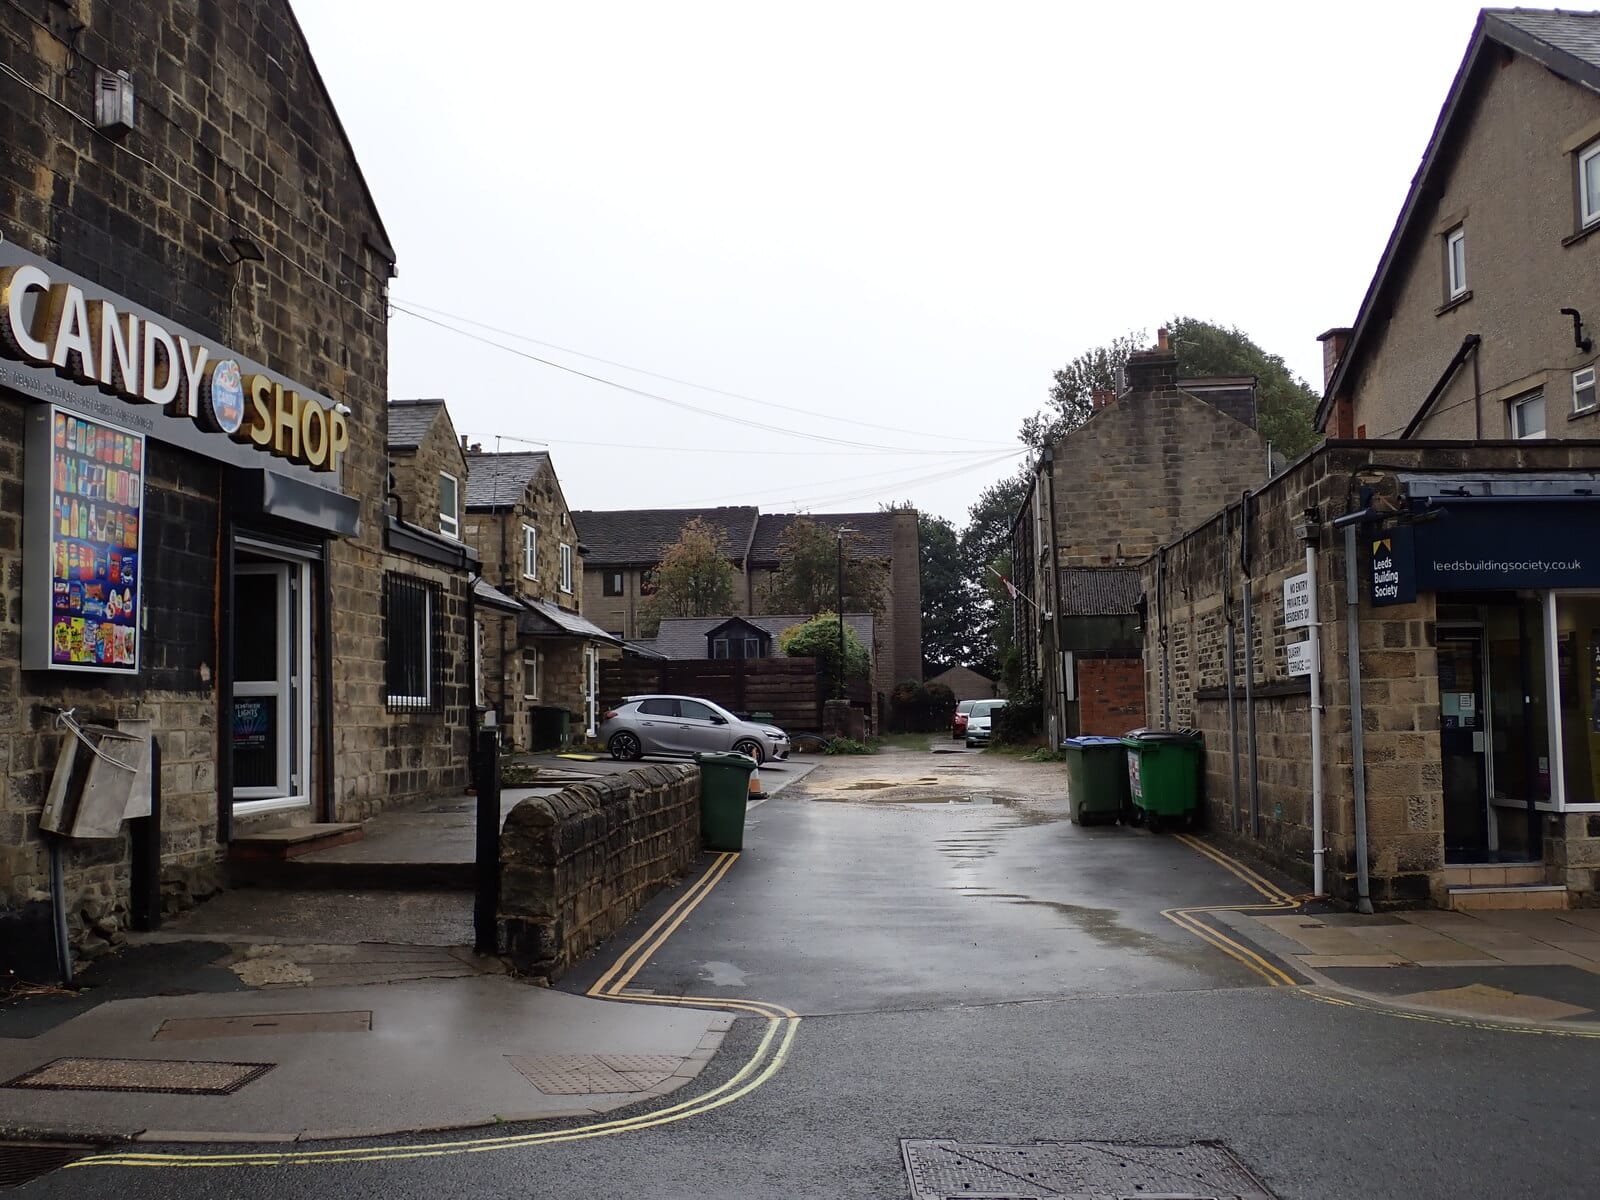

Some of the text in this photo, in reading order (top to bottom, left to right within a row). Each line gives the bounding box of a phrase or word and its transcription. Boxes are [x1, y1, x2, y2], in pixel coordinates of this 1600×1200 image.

[9, 265, 348, 472] CANDY SHOP
[1373, 556, 1392, 570] Leeds
[1433, 560, 1582, 573] leedsbuildingsociety.co.uk
[1374, 570, 1399, 584] Building
[1290, 580, 1308, 594] NO ENTRY
[1375, 584, 1398, 598] Society
[1286, 594, 1309, 609] PRIVATE ROA
[237, 708, 258, 718] LIGHTS
